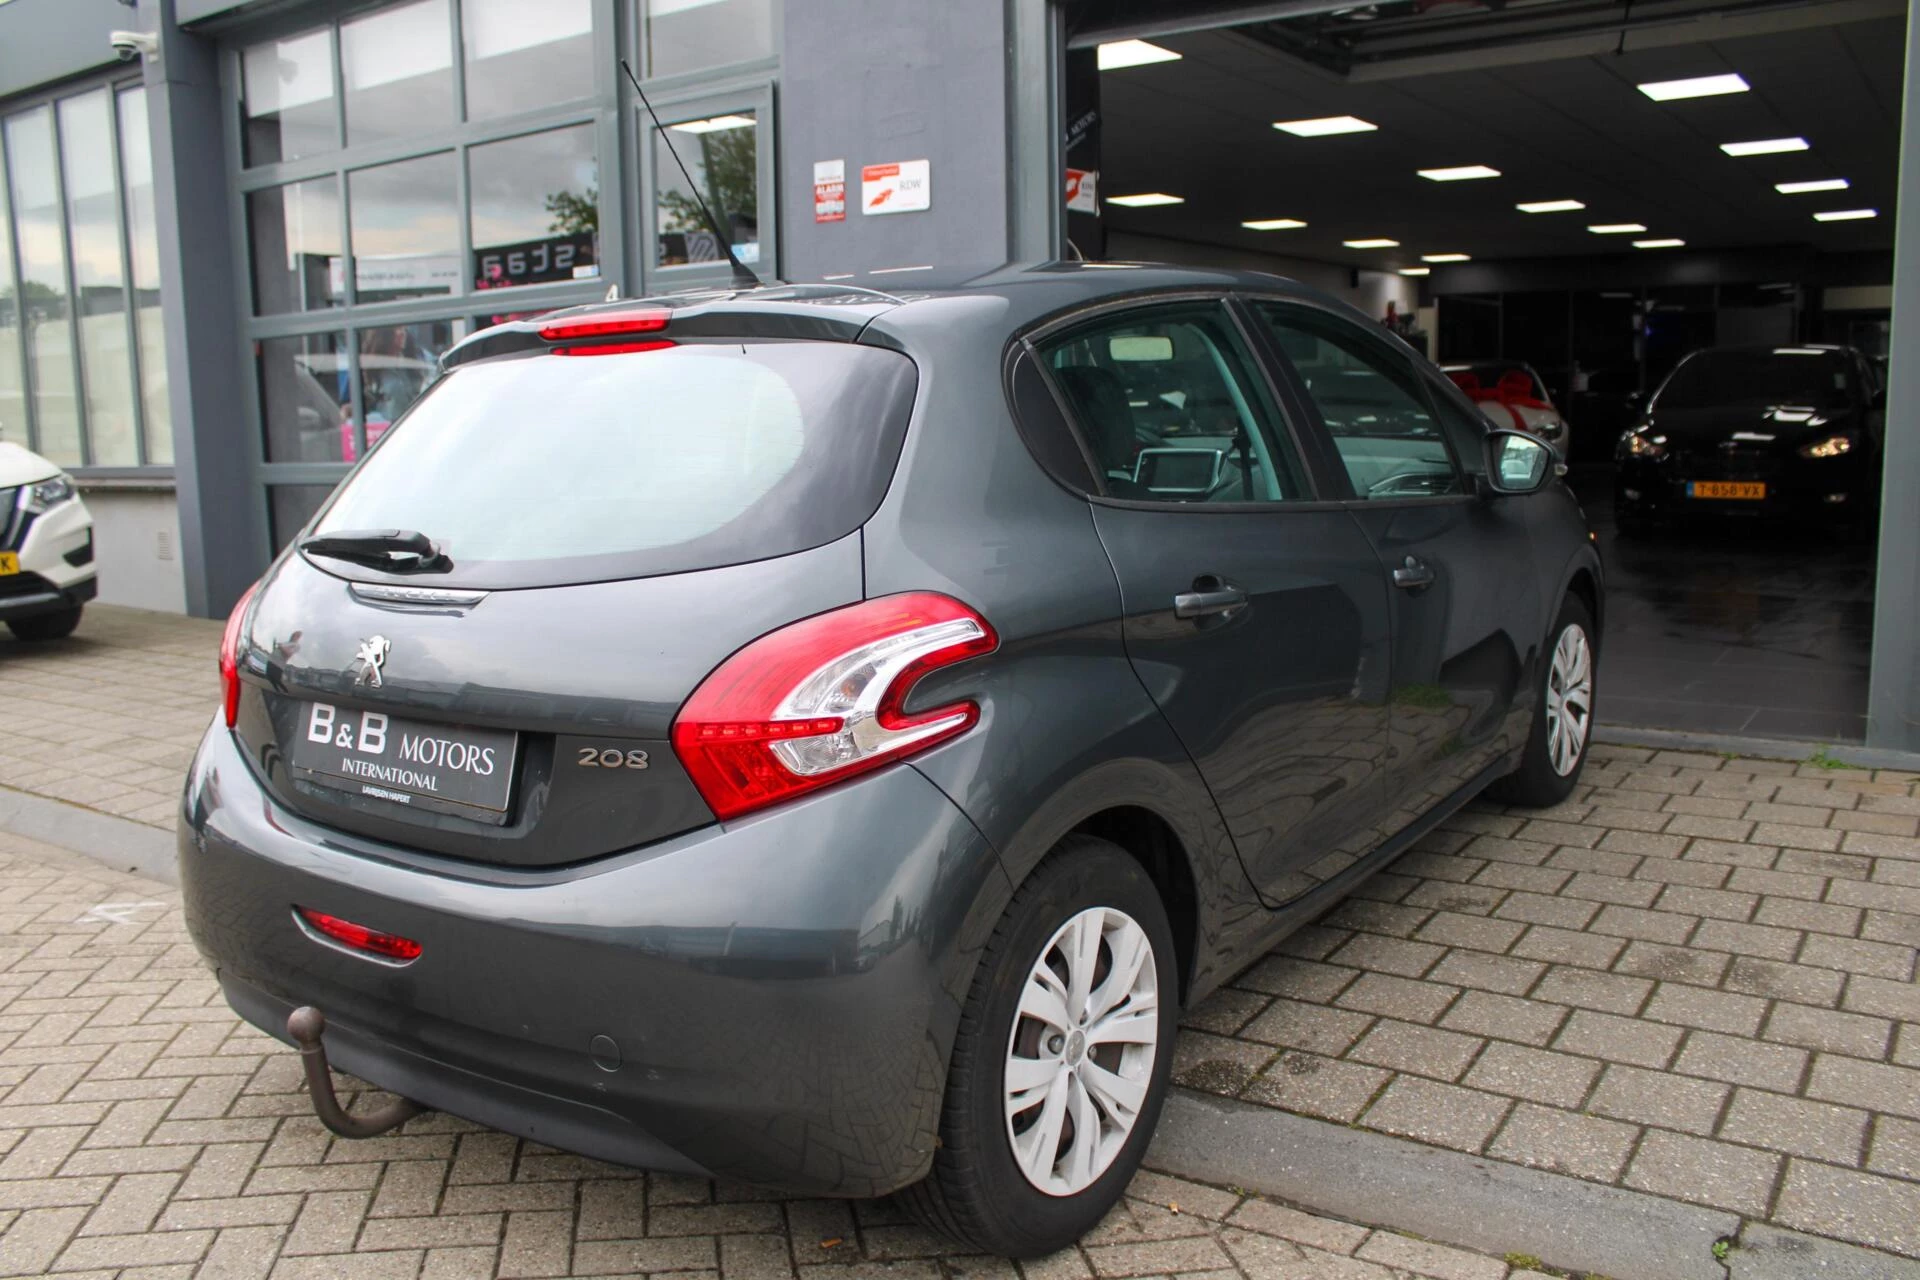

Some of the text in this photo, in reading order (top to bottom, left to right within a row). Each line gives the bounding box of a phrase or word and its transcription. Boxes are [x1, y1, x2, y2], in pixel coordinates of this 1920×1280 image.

[900, 178, 922, 191] RDW
[399, 733, 495, 776] MOTORS
[578, 748, 649, 769] 208
[341, 758, 438, 791] INTERNATIONAL
